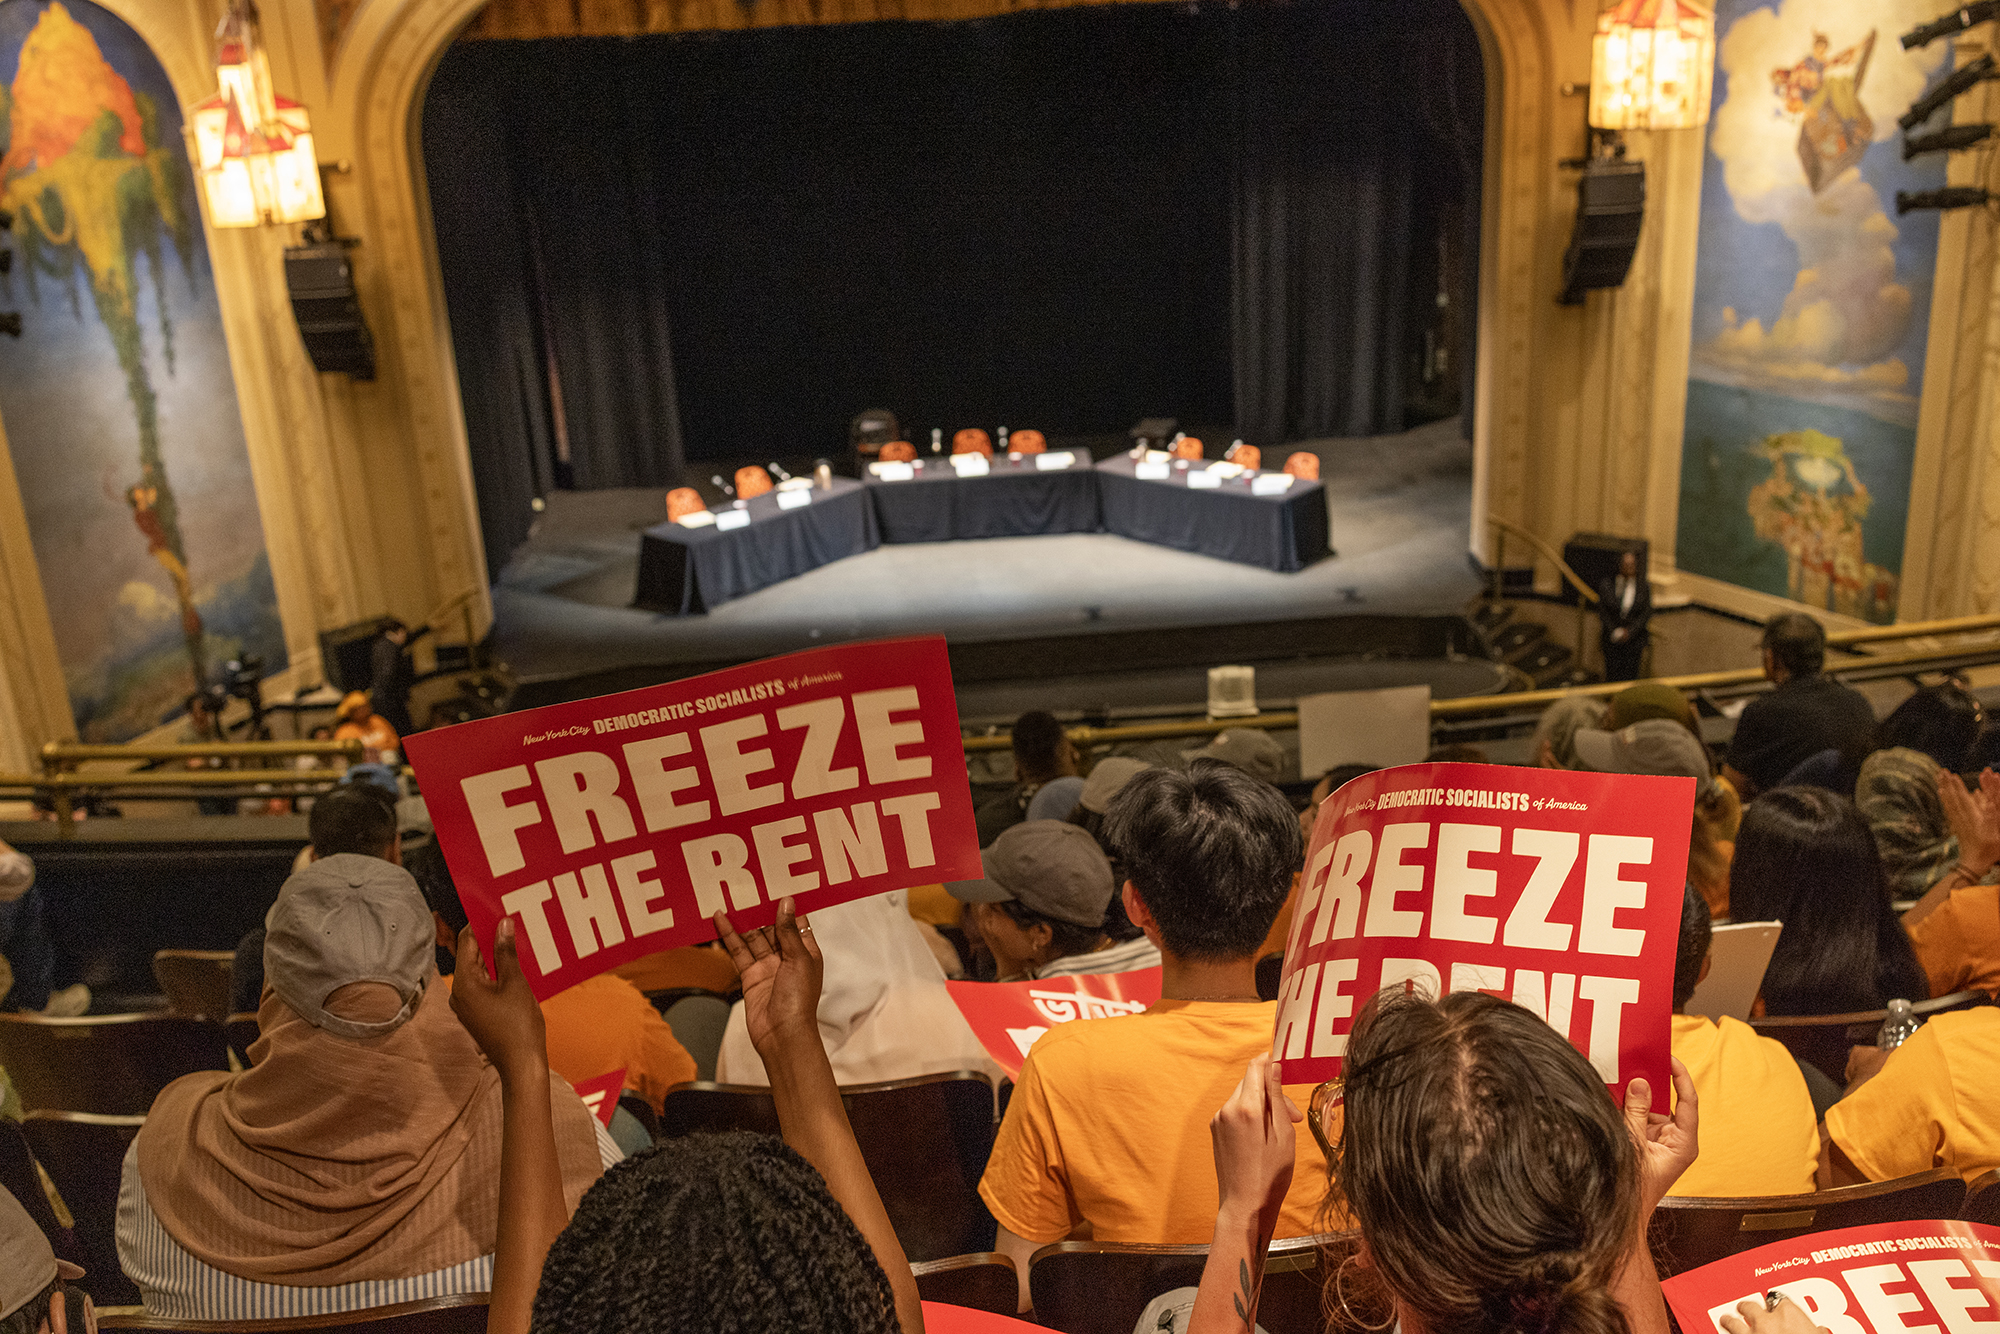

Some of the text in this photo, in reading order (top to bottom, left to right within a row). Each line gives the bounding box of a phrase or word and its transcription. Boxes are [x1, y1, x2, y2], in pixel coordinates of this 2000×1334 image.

[523, 671, 844, 747] New York City DEMOCRATIC SOCIALISTS of America
[460, 685, 933, 879] FREEZE
[1377, 788, 1445, 811] DEMOCRATIC
[1445, 788, 1530, 812] SOCIALISTS
[1532, 798, 1545, 811] of
[1545, 798, 1589, 812] America
[501, 791, 942, 976] THE RENT
[1285, 822, 1654, 968] FREEZE
[1755, 1267, 1773, 1277] New
[1772, 1260, 1793, 1272] York
[1791, 1256, 1811, 1266] City
[1810, 1239, 1898, 1264] DEMOCRATIC
[1896, 1236, 1973, 1251] SOCIALISTS
[1707, 1258, 2000, 1334] REE
